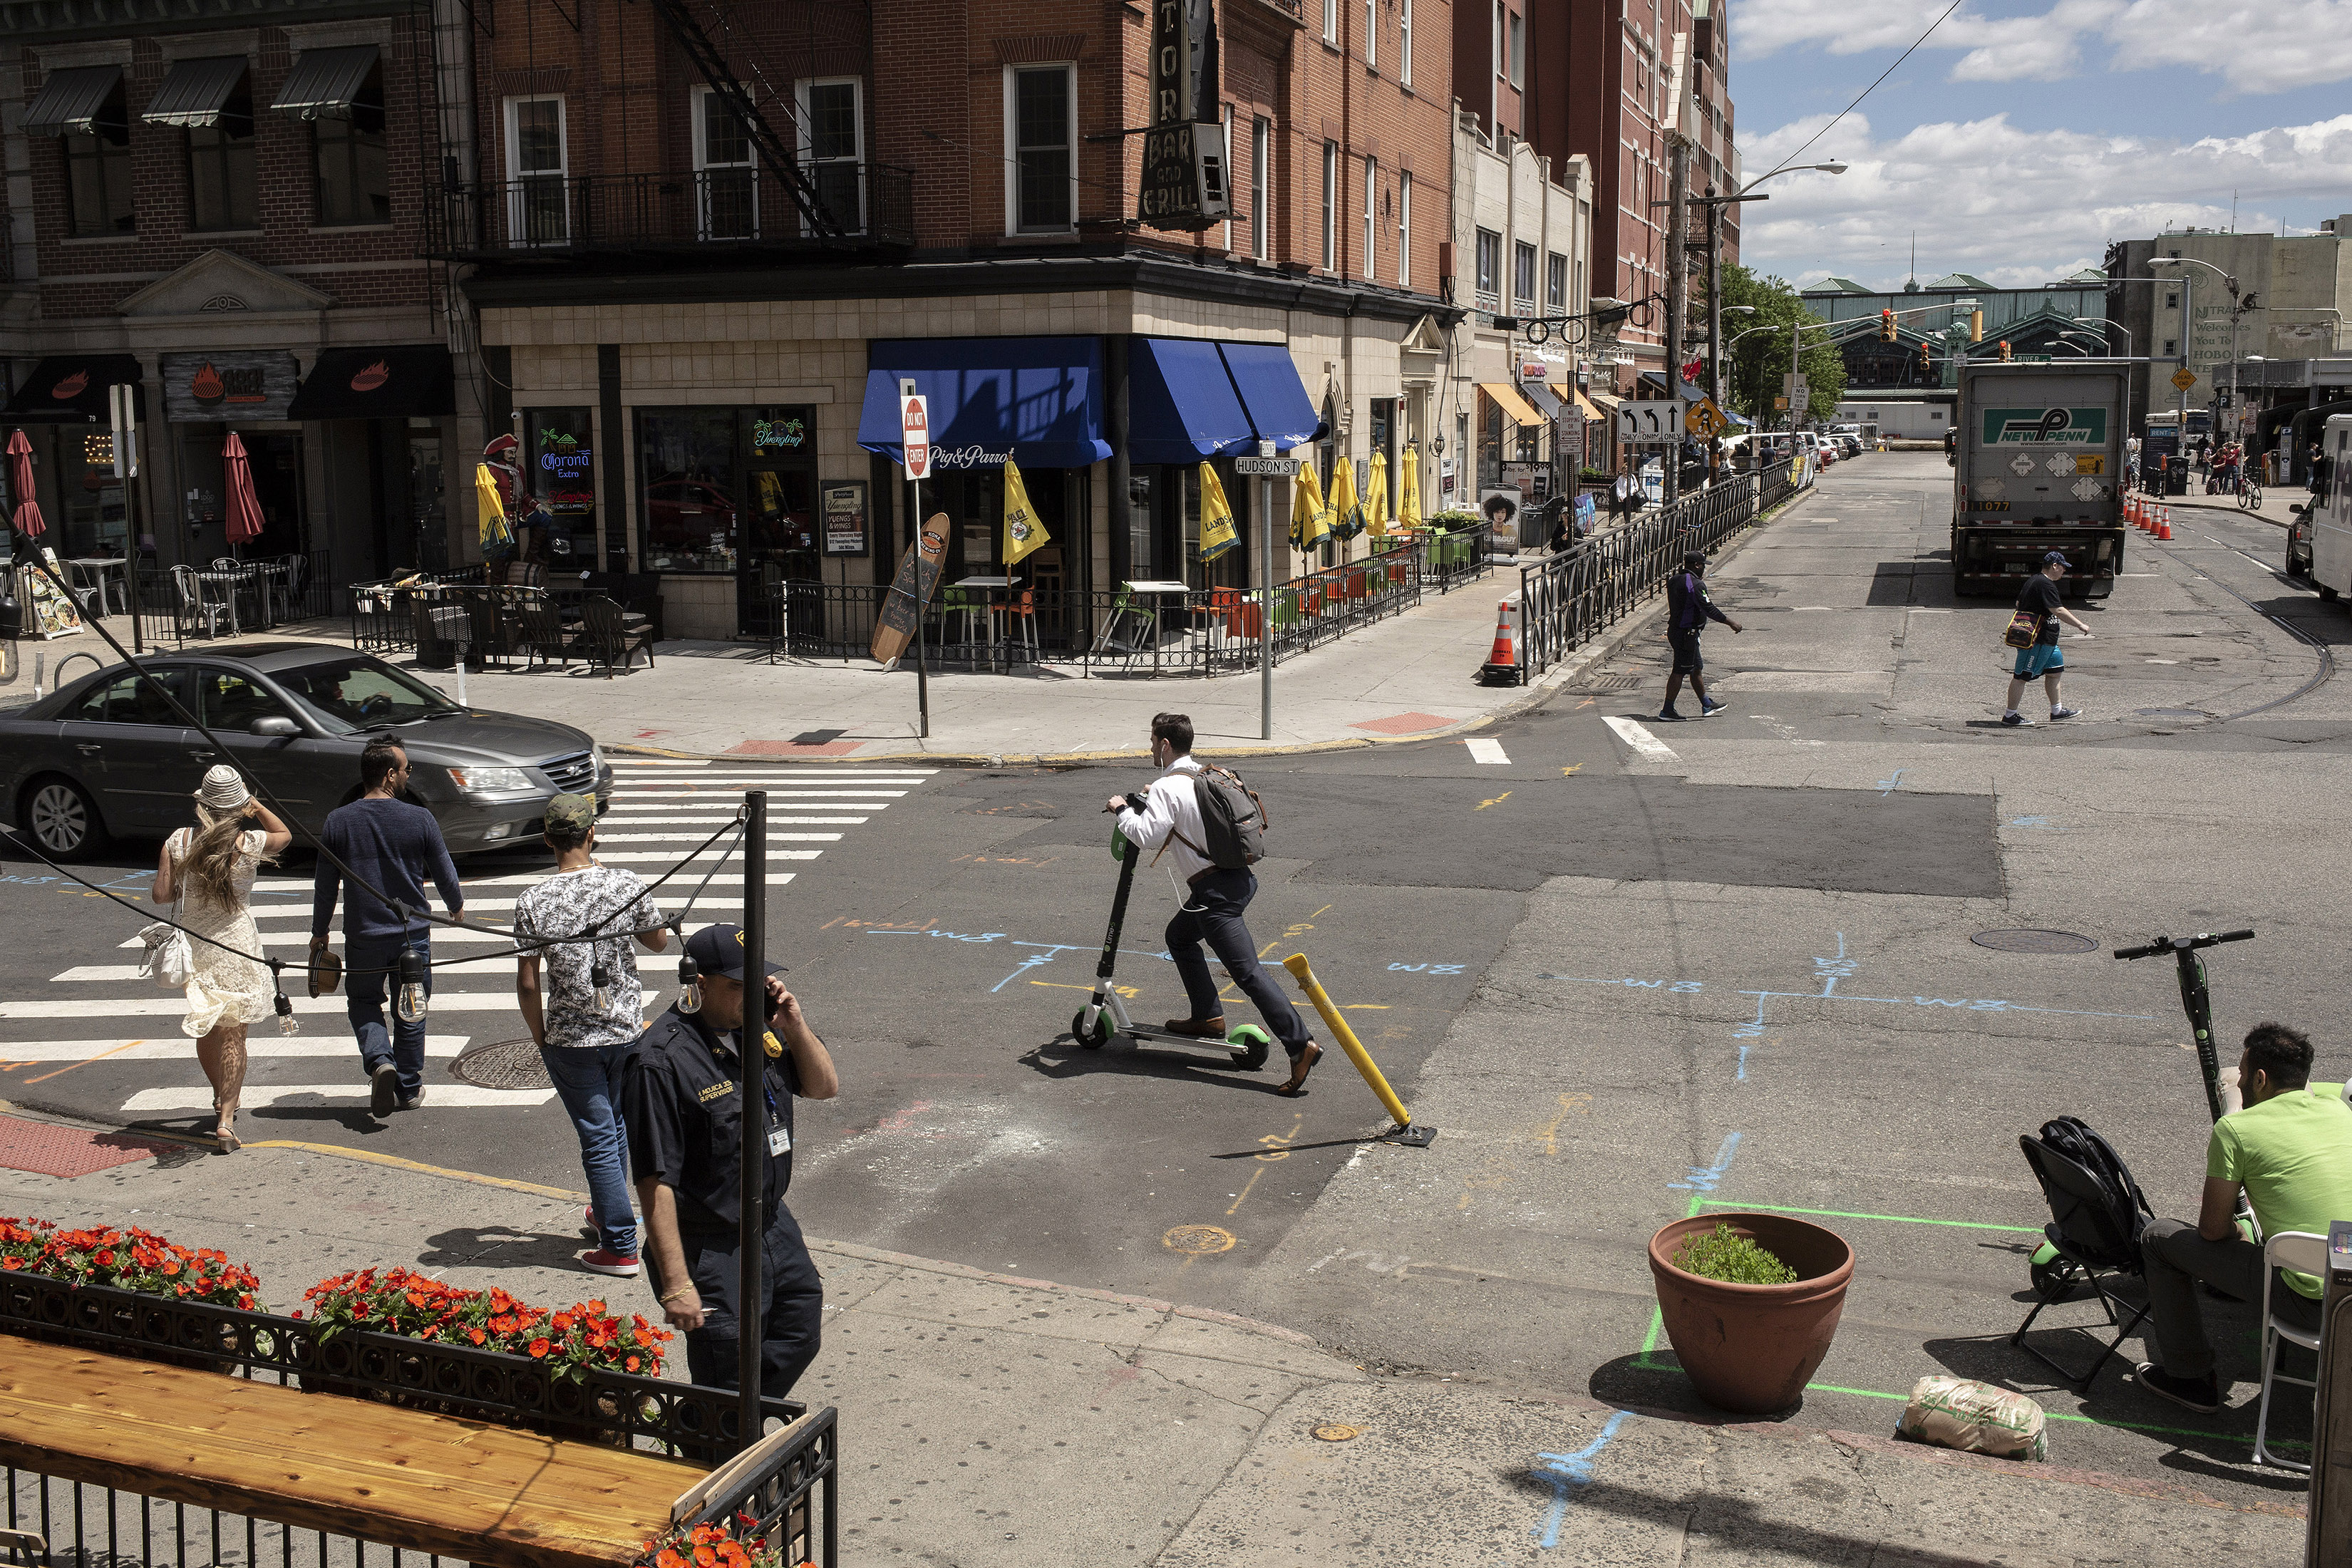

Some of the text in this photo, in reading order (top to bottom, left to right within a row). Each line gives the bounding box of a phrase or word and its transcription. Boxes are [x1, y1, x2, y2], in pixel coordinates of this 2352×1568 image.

[1149, 129, 1190, 169] BAR
[1143, 185, 1197, 215] GRILL
[2194, 336, 2232, 345] You To
[2194, 349, 2259, 359] HOBOEN
[907, 412, 924, 427] DO NOT
[755, 430, 803, 448] Yuengling
[2000, 430, 2088, 442] NEW PENN
[542, 453, 589, 470] Corona
[909, 448, 924, 463] ENTER
[1237, 460, 1299, 473] HUDSON ST
[1502, 463, 1507, 472] 3
[557, 469, 579, 478] Extra
[547, 490, 593, 505] Yuengling
[826, 499, 862, 512] Yuengling
[828, 515, 851, 523] YUENGS
[928, 531, 941, 542] KONA
[699, 1085, 734, 1103] SUPERVISOR
[702, 1083, 723, 1095] MOJICA
